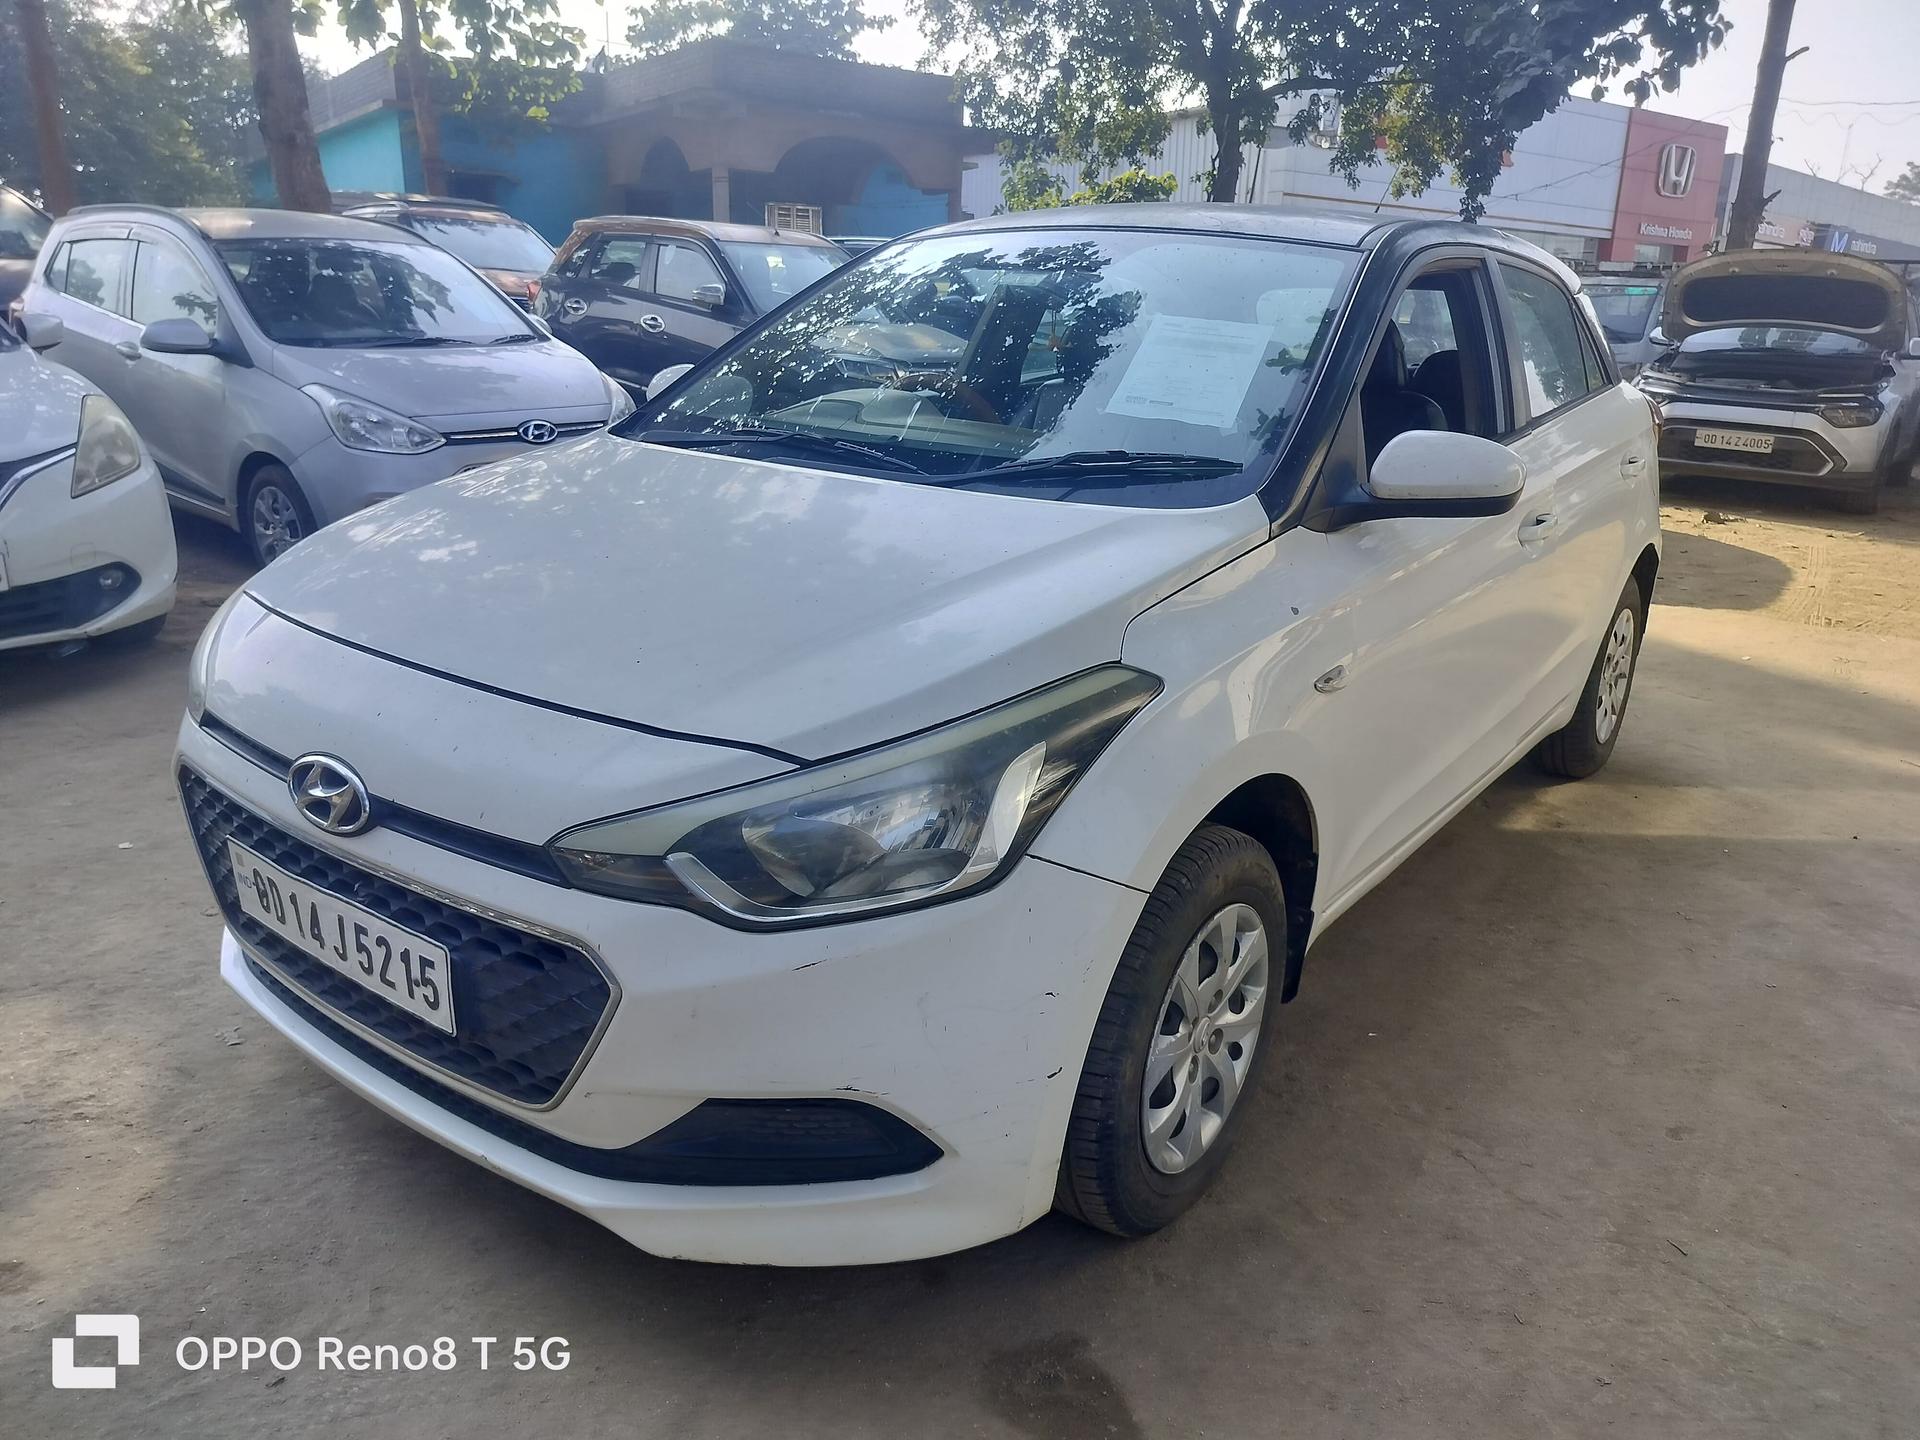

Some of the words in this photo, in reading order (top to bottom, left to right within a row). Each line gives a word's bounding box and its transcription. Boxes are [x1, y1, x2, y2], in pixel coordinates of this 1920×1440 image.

[1669, 225, 1692, 240] Honda
[1742, 438, 1770, 450] 4005
[333, 914, 348, 962] J
[354, 922, 440, 1011] 5215
